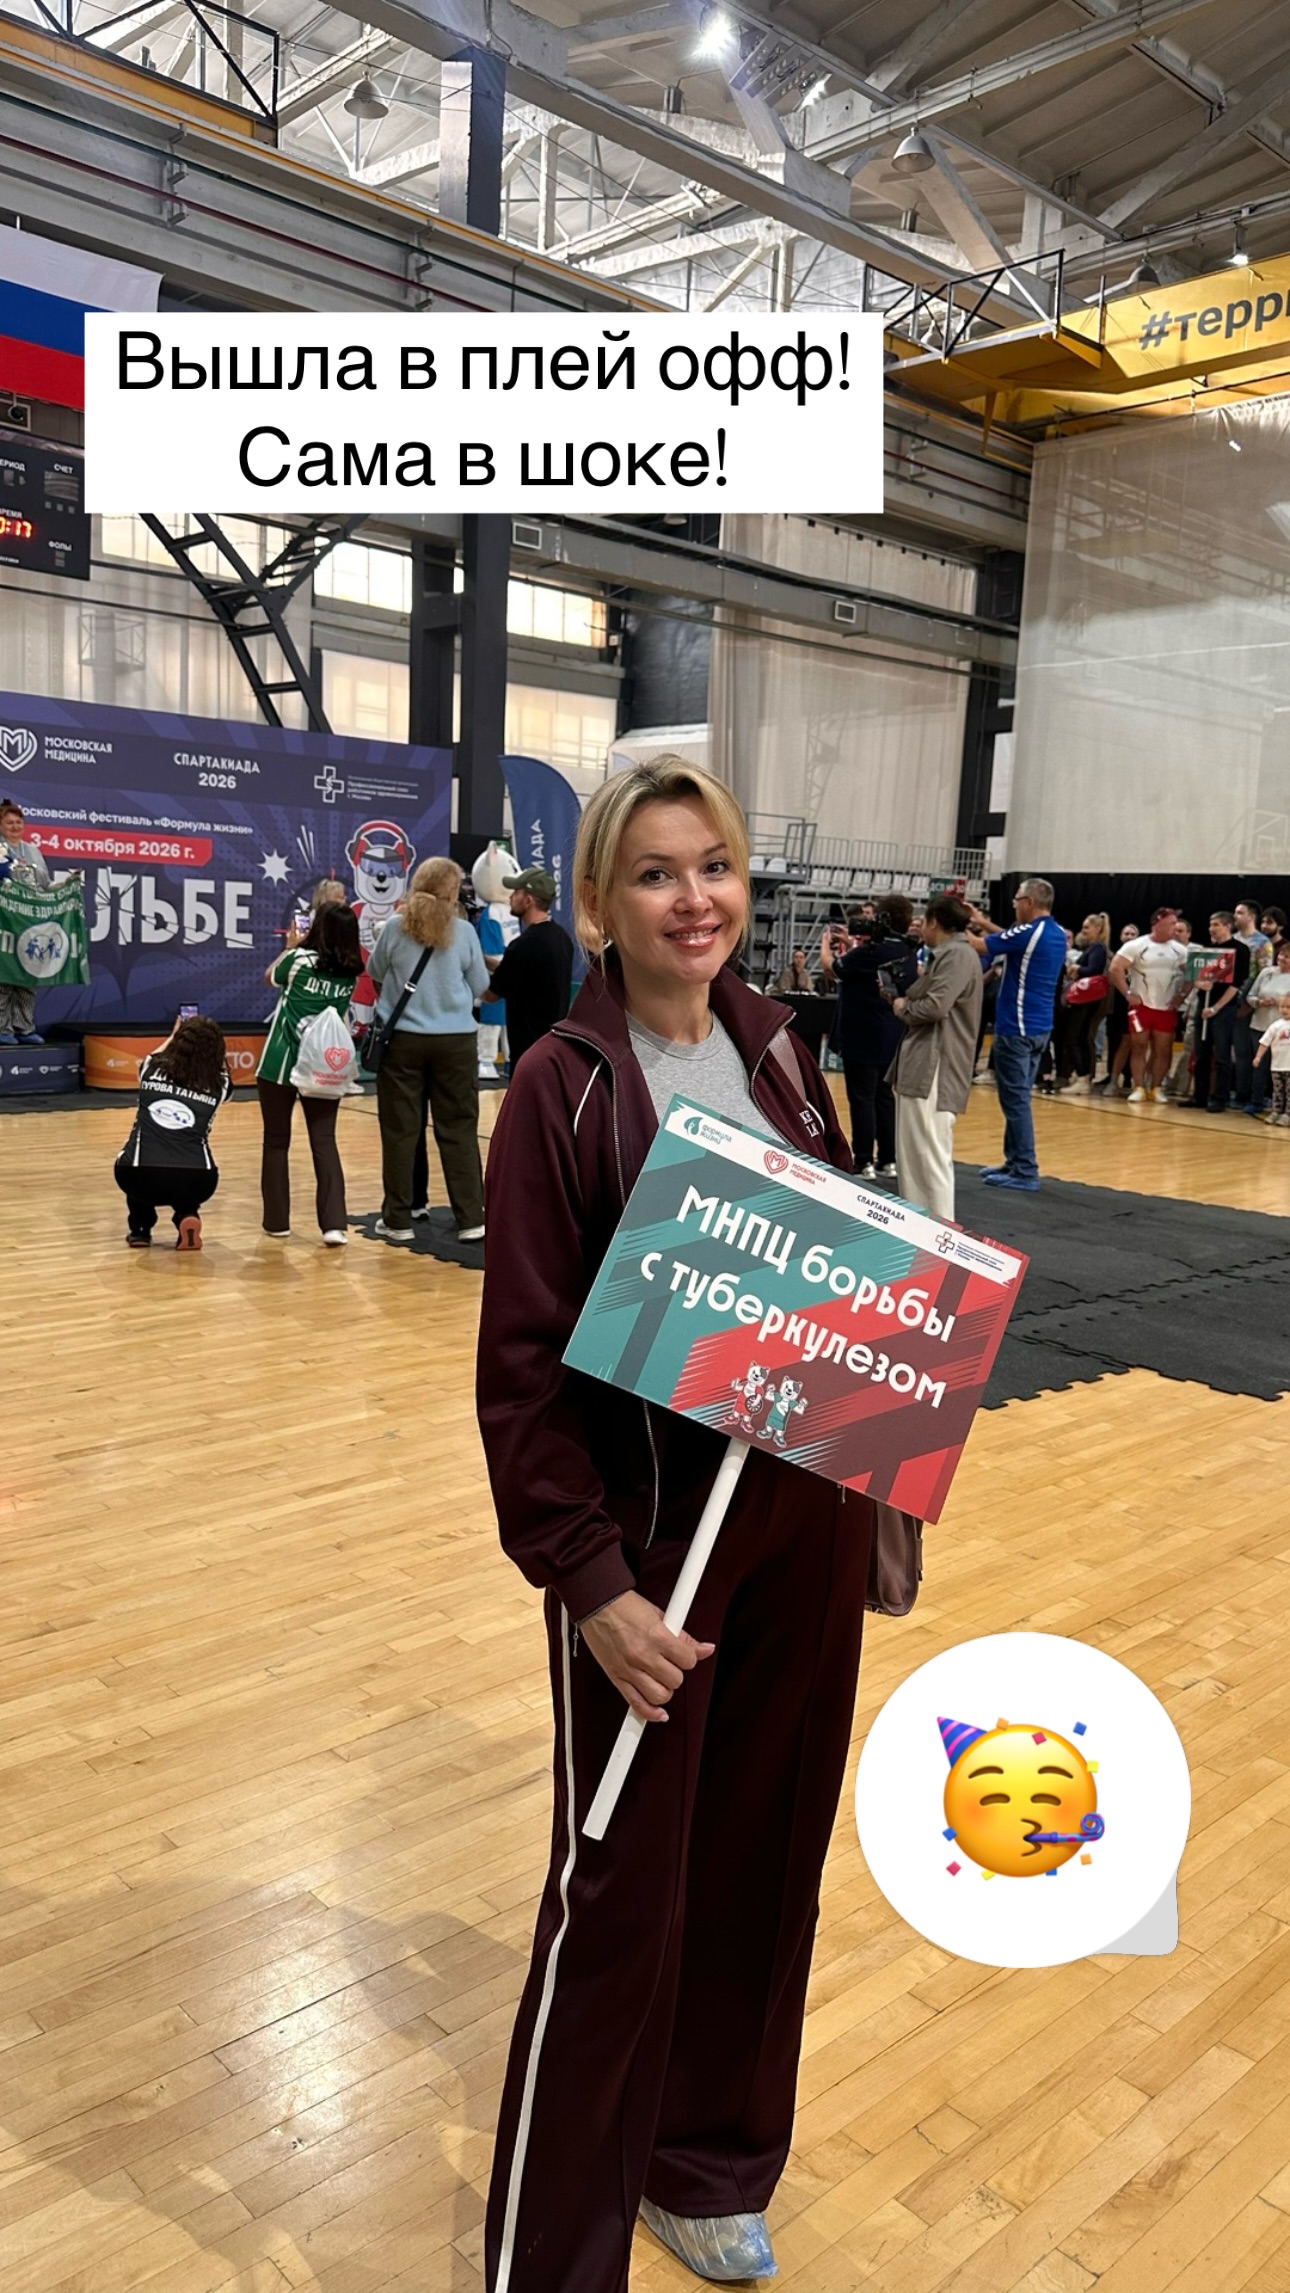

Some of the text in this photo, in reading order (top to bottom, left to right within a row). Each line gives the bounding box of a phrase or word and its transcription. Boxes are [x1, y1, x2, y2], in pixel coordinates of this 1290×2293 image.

[54, 463, 73, 474] СЧЕТ
[48, 541, 72, 551] ФОЛЫ
[44, 736, 112, 754] МОСКОВСКАЯ
[44, 749, 96, 764] МЕДИЦИНА
[173, 752, 260, 774] СПАРТАКИАДА
[198, 772, 236, 789] 2026
[20, 806, 254, 834] осковский фестиваль «Формула жизни»
[30, 832, 195, 859] 3-4 октября 2026 г.
[54, 866, 254, 949] ЛЬБЕ
[856, 1194, 906, 1222] СПАРТАКИАДА
[866, 1208, 889, 1225] 2026
[676, 1185, 956, 1343] МНПЦ борьбы
[640, 1252, 946, 1408] с туберкулезом
